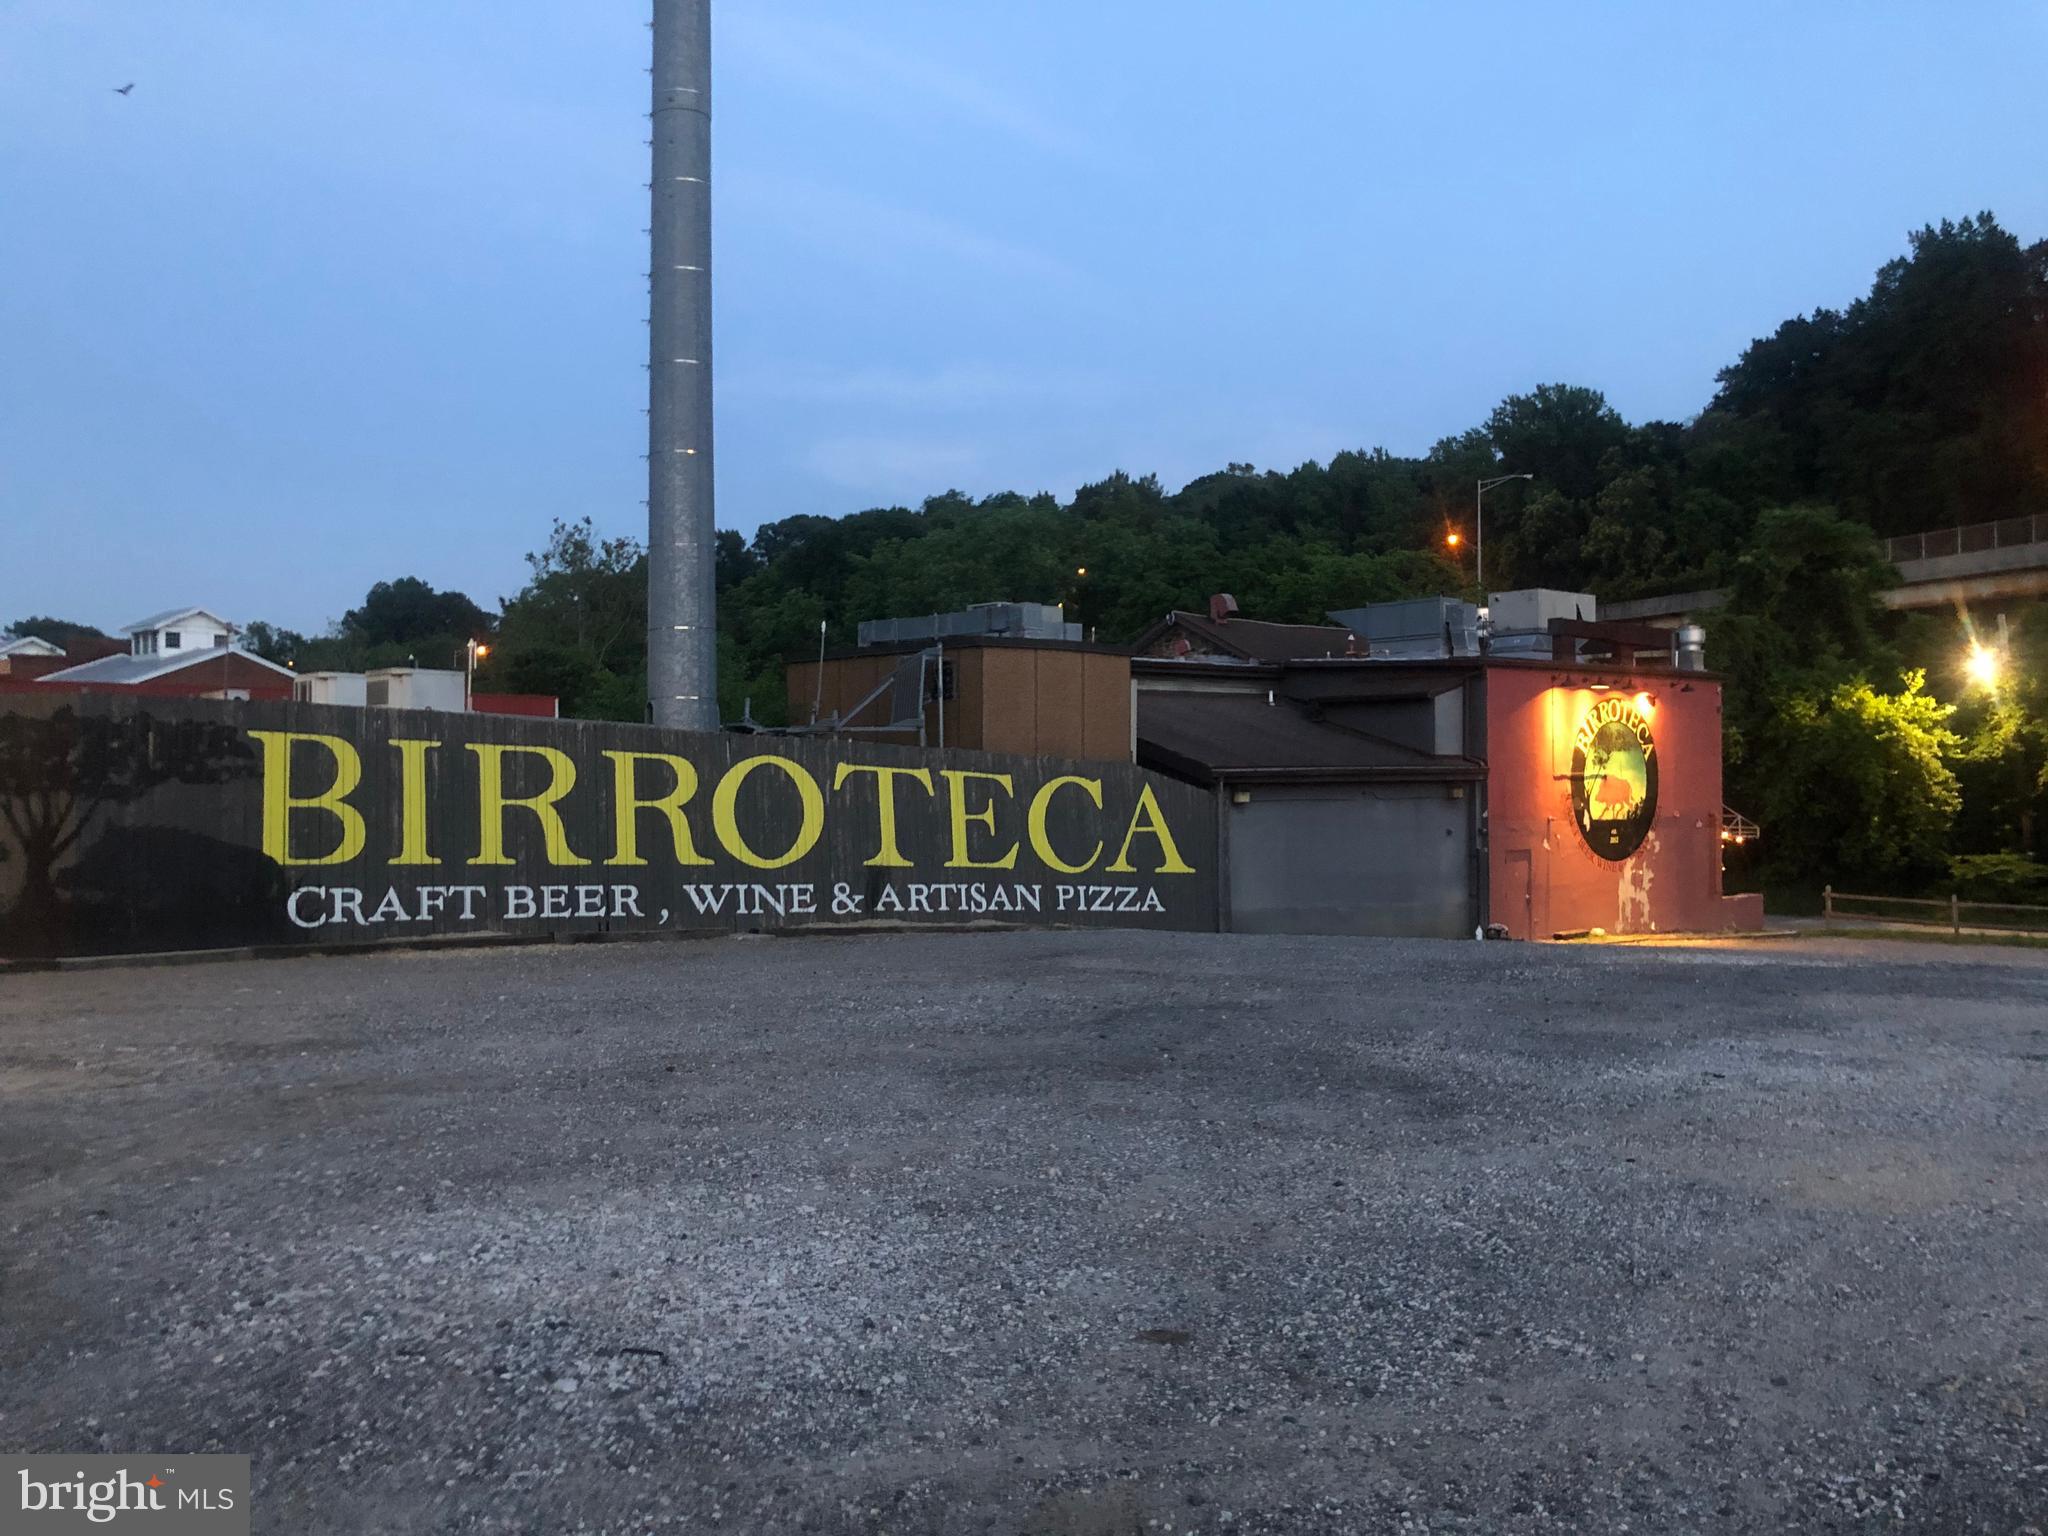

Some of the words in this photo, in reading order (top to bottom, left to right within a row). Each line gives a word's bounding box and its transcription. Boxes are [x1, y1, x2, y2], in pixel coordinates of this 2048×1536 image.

[1575, 699, 1654, 762] BIRROTECA
[247, 730, 1196, 874] BIRROTECA
[287, 885, 487, 928] CRAFT
[683, 884, 815, 917] WINE
[832, 882, 865, 914] &
[874, 883, 1041, 913] ARTISAN
[1056, 885, 1166, 912] PIZZA
